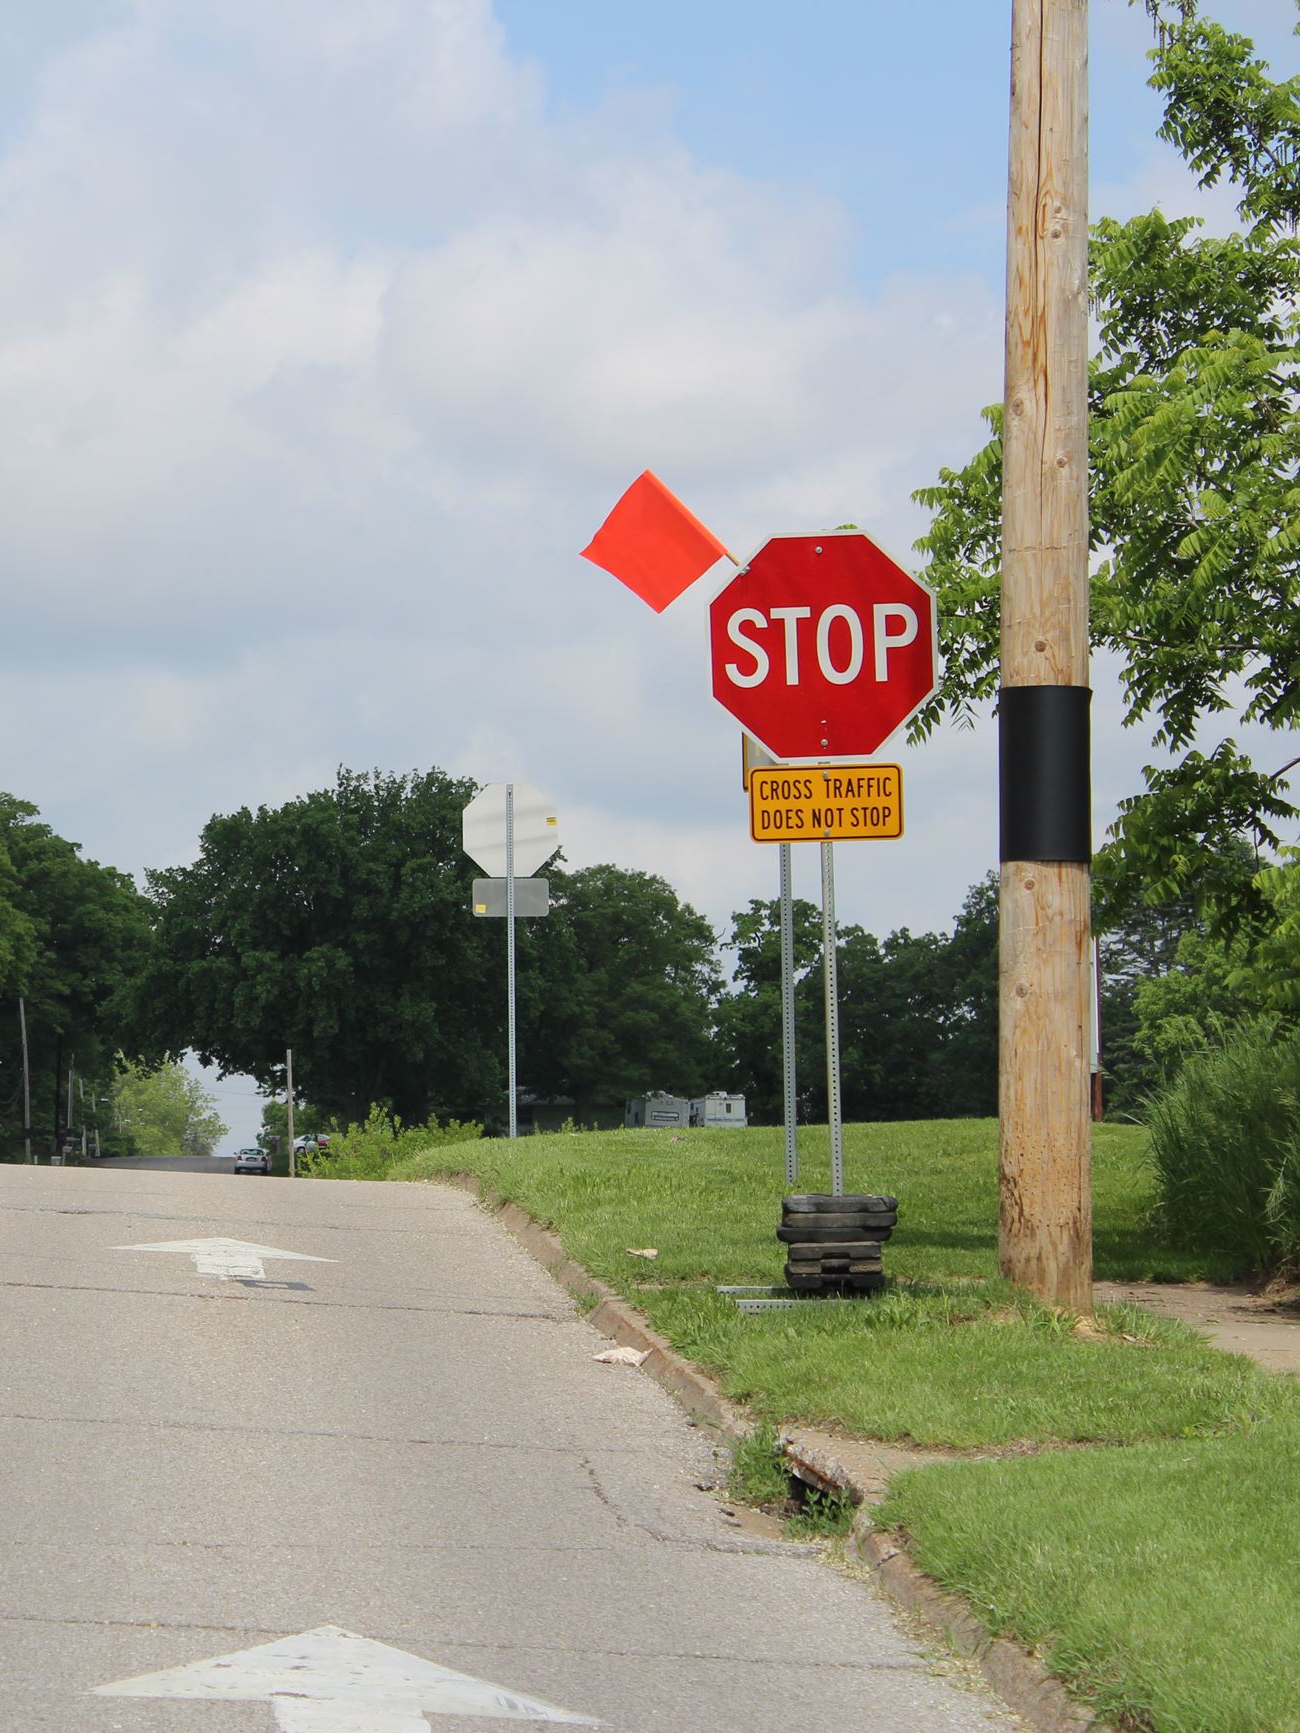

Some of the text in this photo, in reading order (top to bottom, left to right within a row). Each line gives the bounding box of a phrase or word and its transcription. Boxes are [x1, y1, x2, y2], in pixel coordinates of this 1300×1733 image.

[724, 602, 919, 689] STOP
[759, 776, 893, 801] CROSS TRAFFIC
[761, 806, 892, 830] DOES NOT STOP
